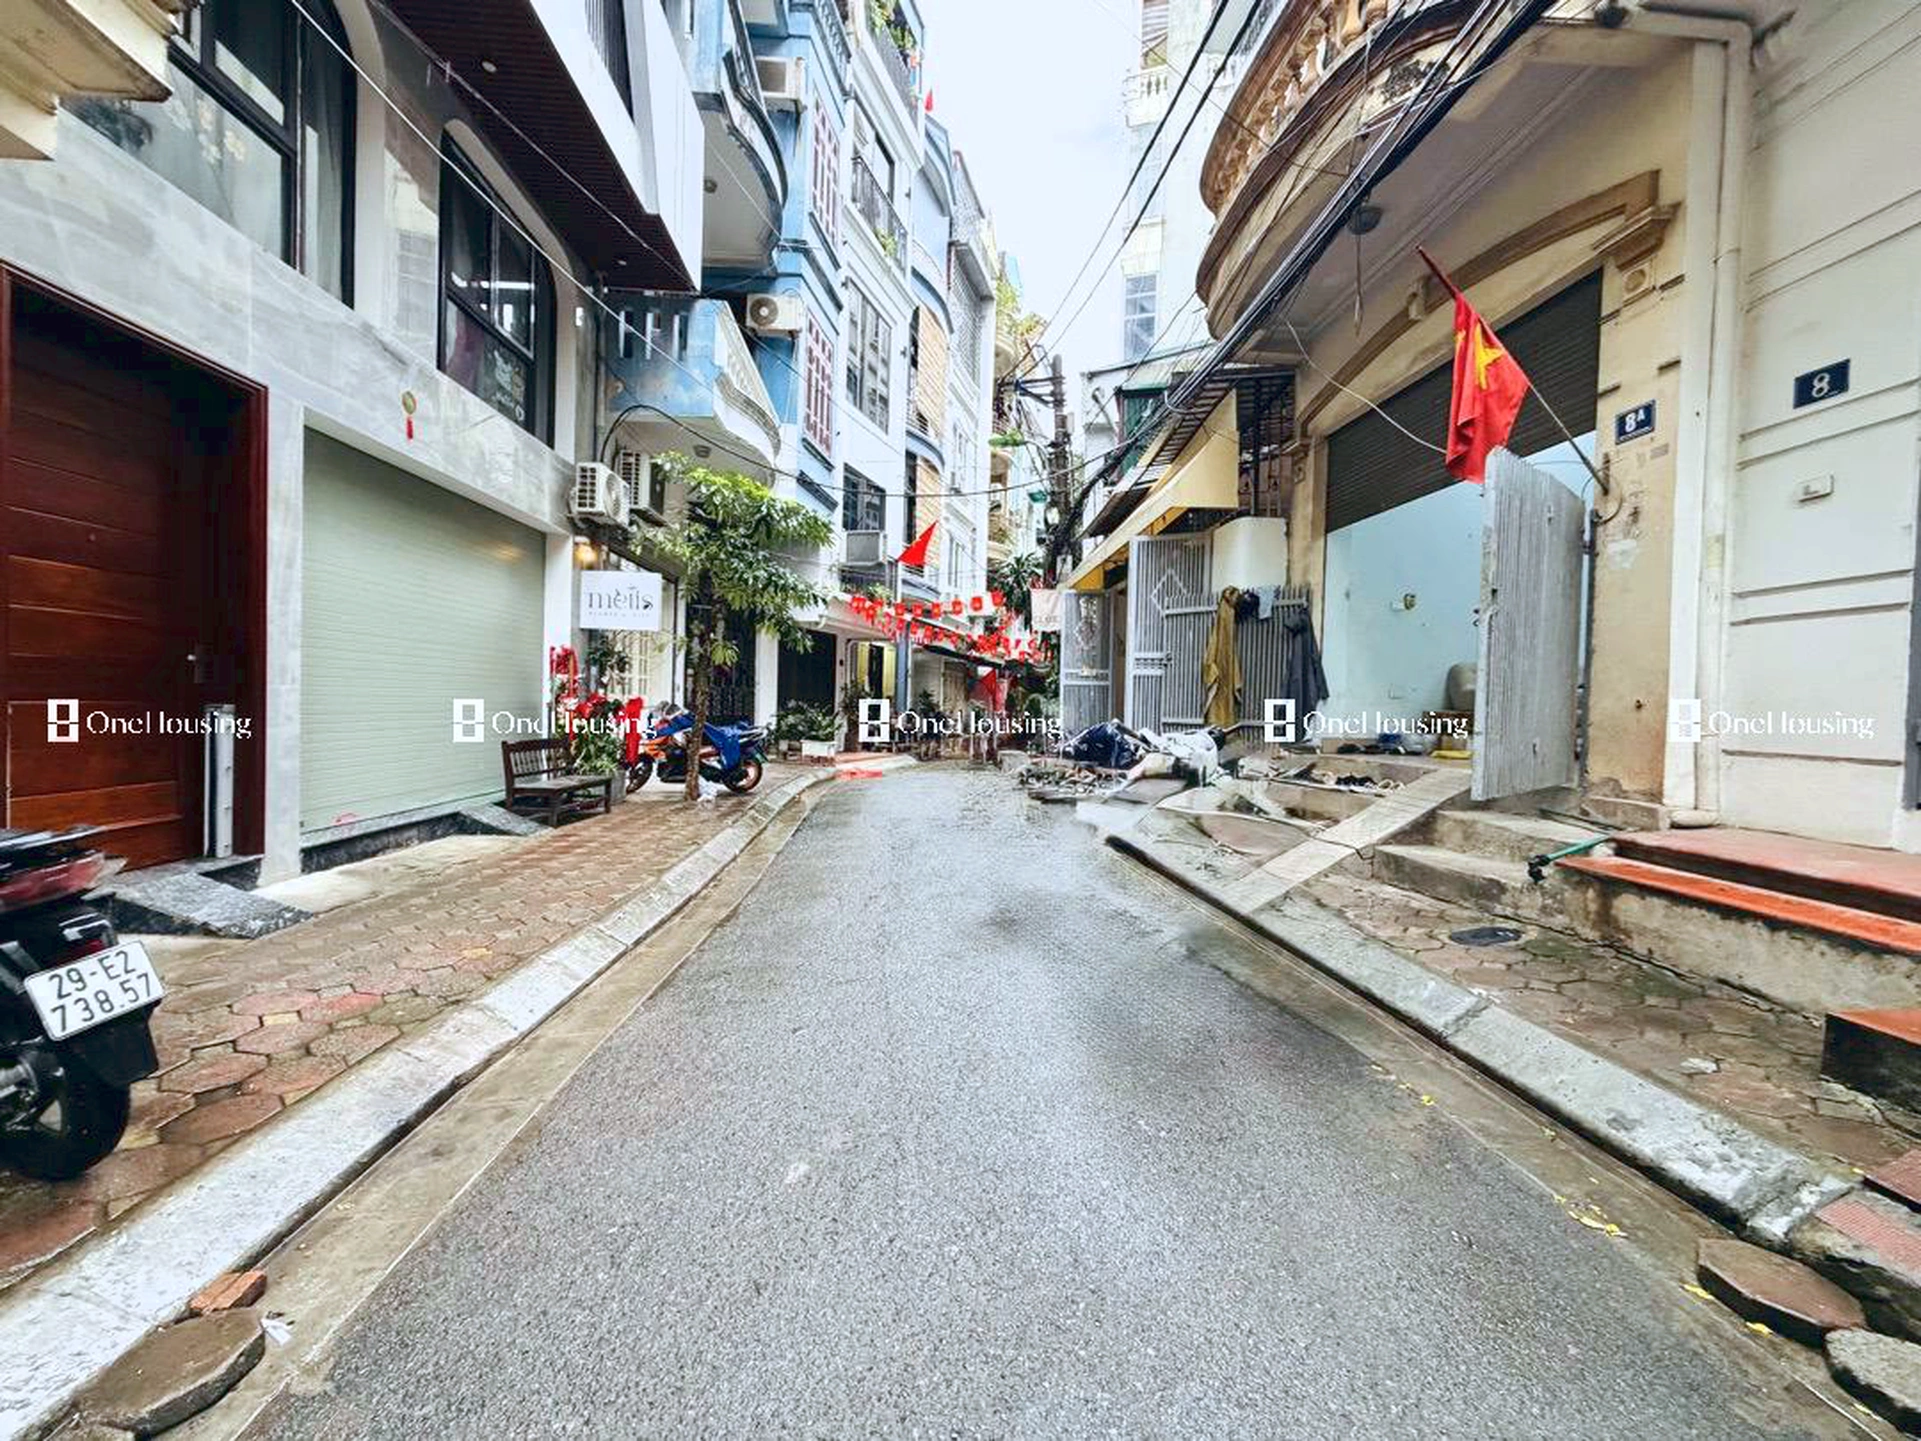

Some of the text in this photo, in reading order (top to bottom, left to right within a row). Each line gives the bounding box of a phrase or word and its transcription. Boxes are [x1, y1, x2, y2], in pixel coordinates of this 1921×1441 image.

[1812, 372, 1830, 398] 8
[1625, 408, 1646, 433] 8A
[49, 950, 136, 1000] 29-E2
[51, 973, 151, 1032] 738.57
